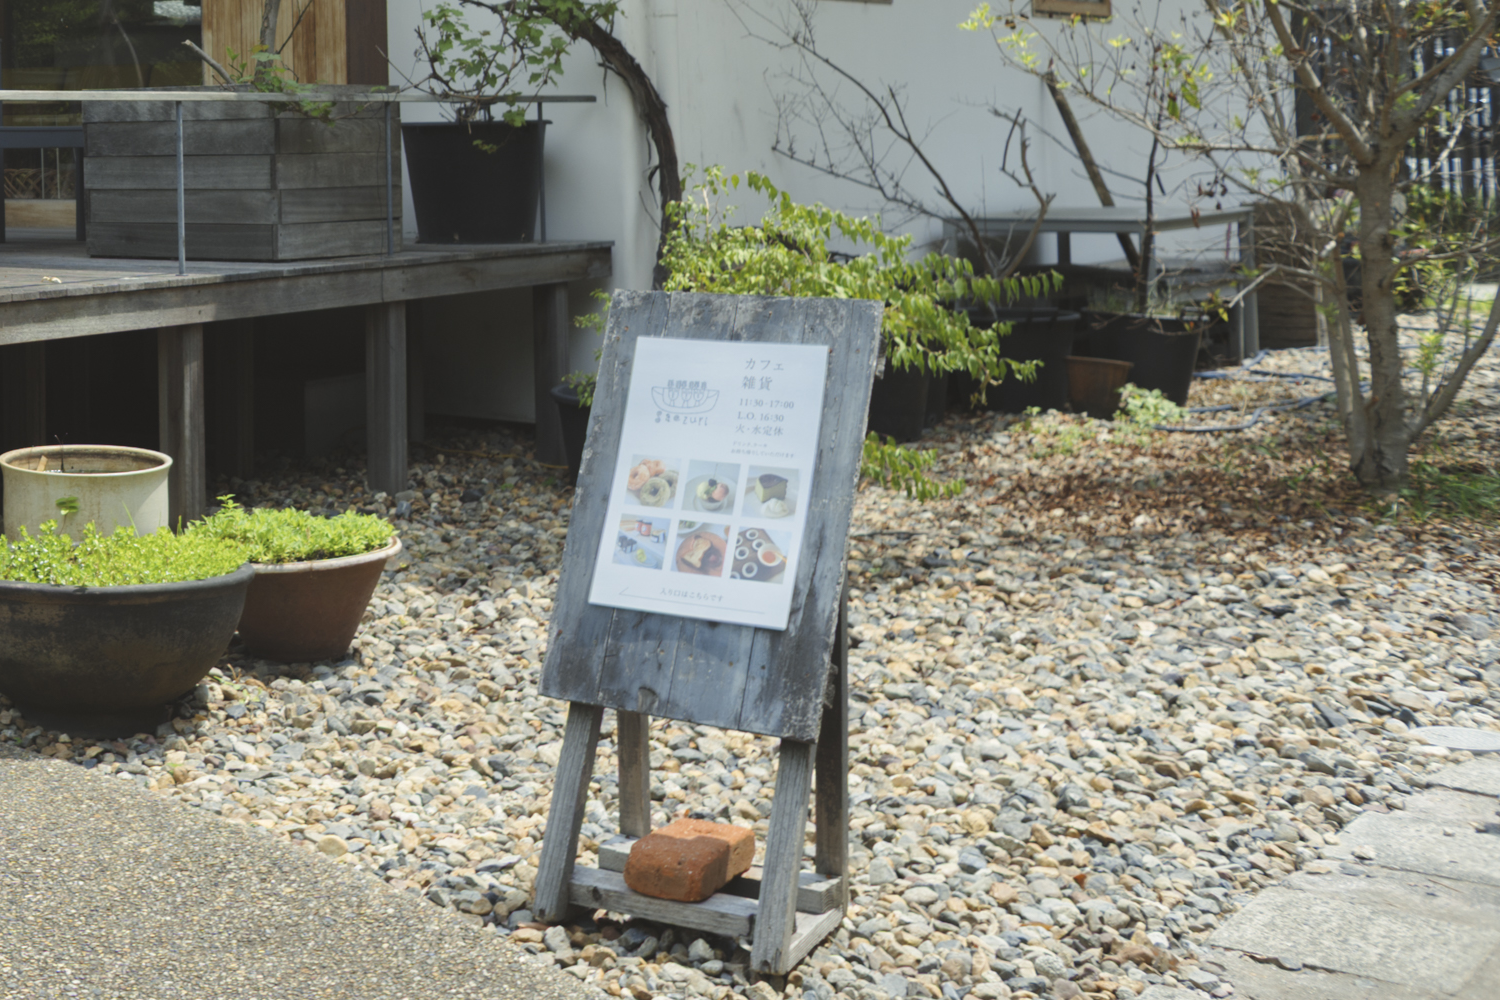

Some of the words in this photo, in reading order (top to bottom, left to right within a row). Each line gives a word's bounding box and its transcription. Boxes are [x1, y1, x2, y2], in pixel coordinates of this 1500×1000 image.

[745, 358, 784, 371] カフェ
[742, 375, 773, 391] 雑貨
[737, 411, 757, 421] L.O.
[759, 412, 785, 423] 16:30
[660, 588, 724, 602] 入り口はこちらです
